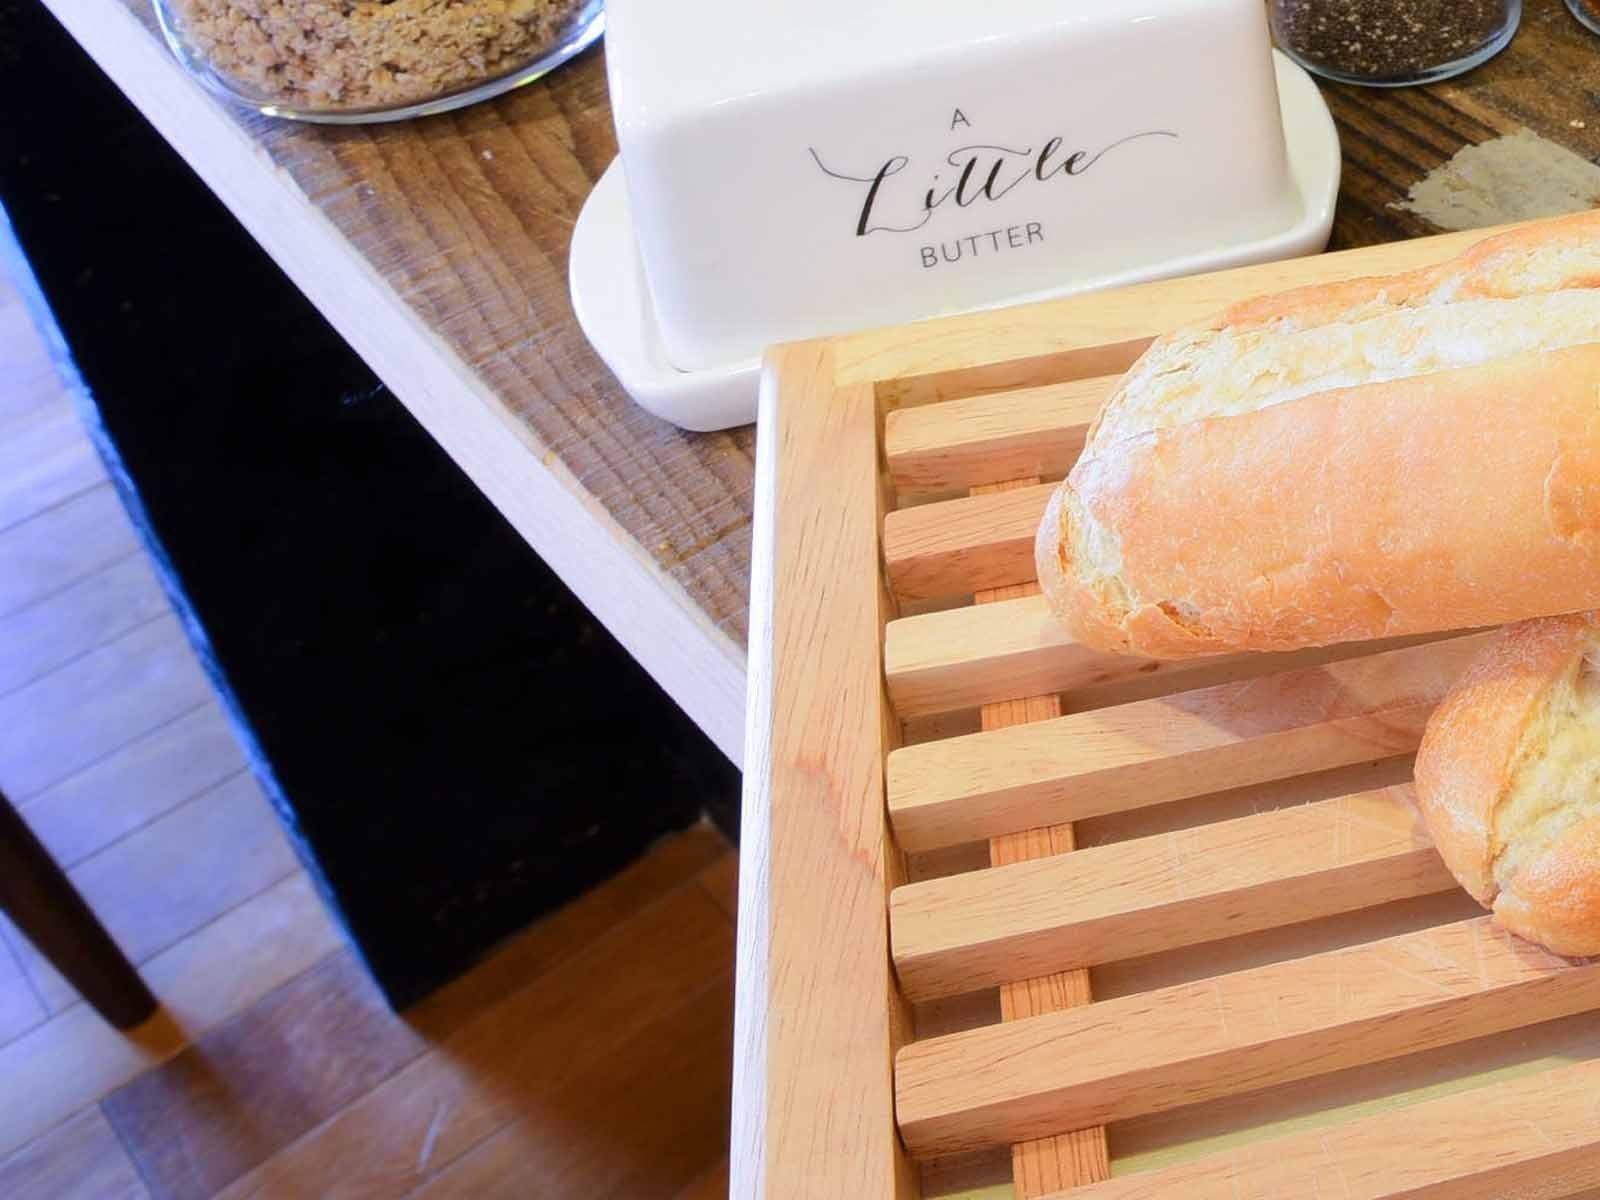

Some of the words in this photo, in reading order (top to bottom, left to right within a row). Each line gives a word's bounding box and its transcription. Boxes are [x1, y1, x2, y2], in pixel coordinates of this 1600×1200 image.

[950, 108, 972, 131] A
[809, 131, 1179, 237] Little
[919, 221, 1045, 269] BUTTER
